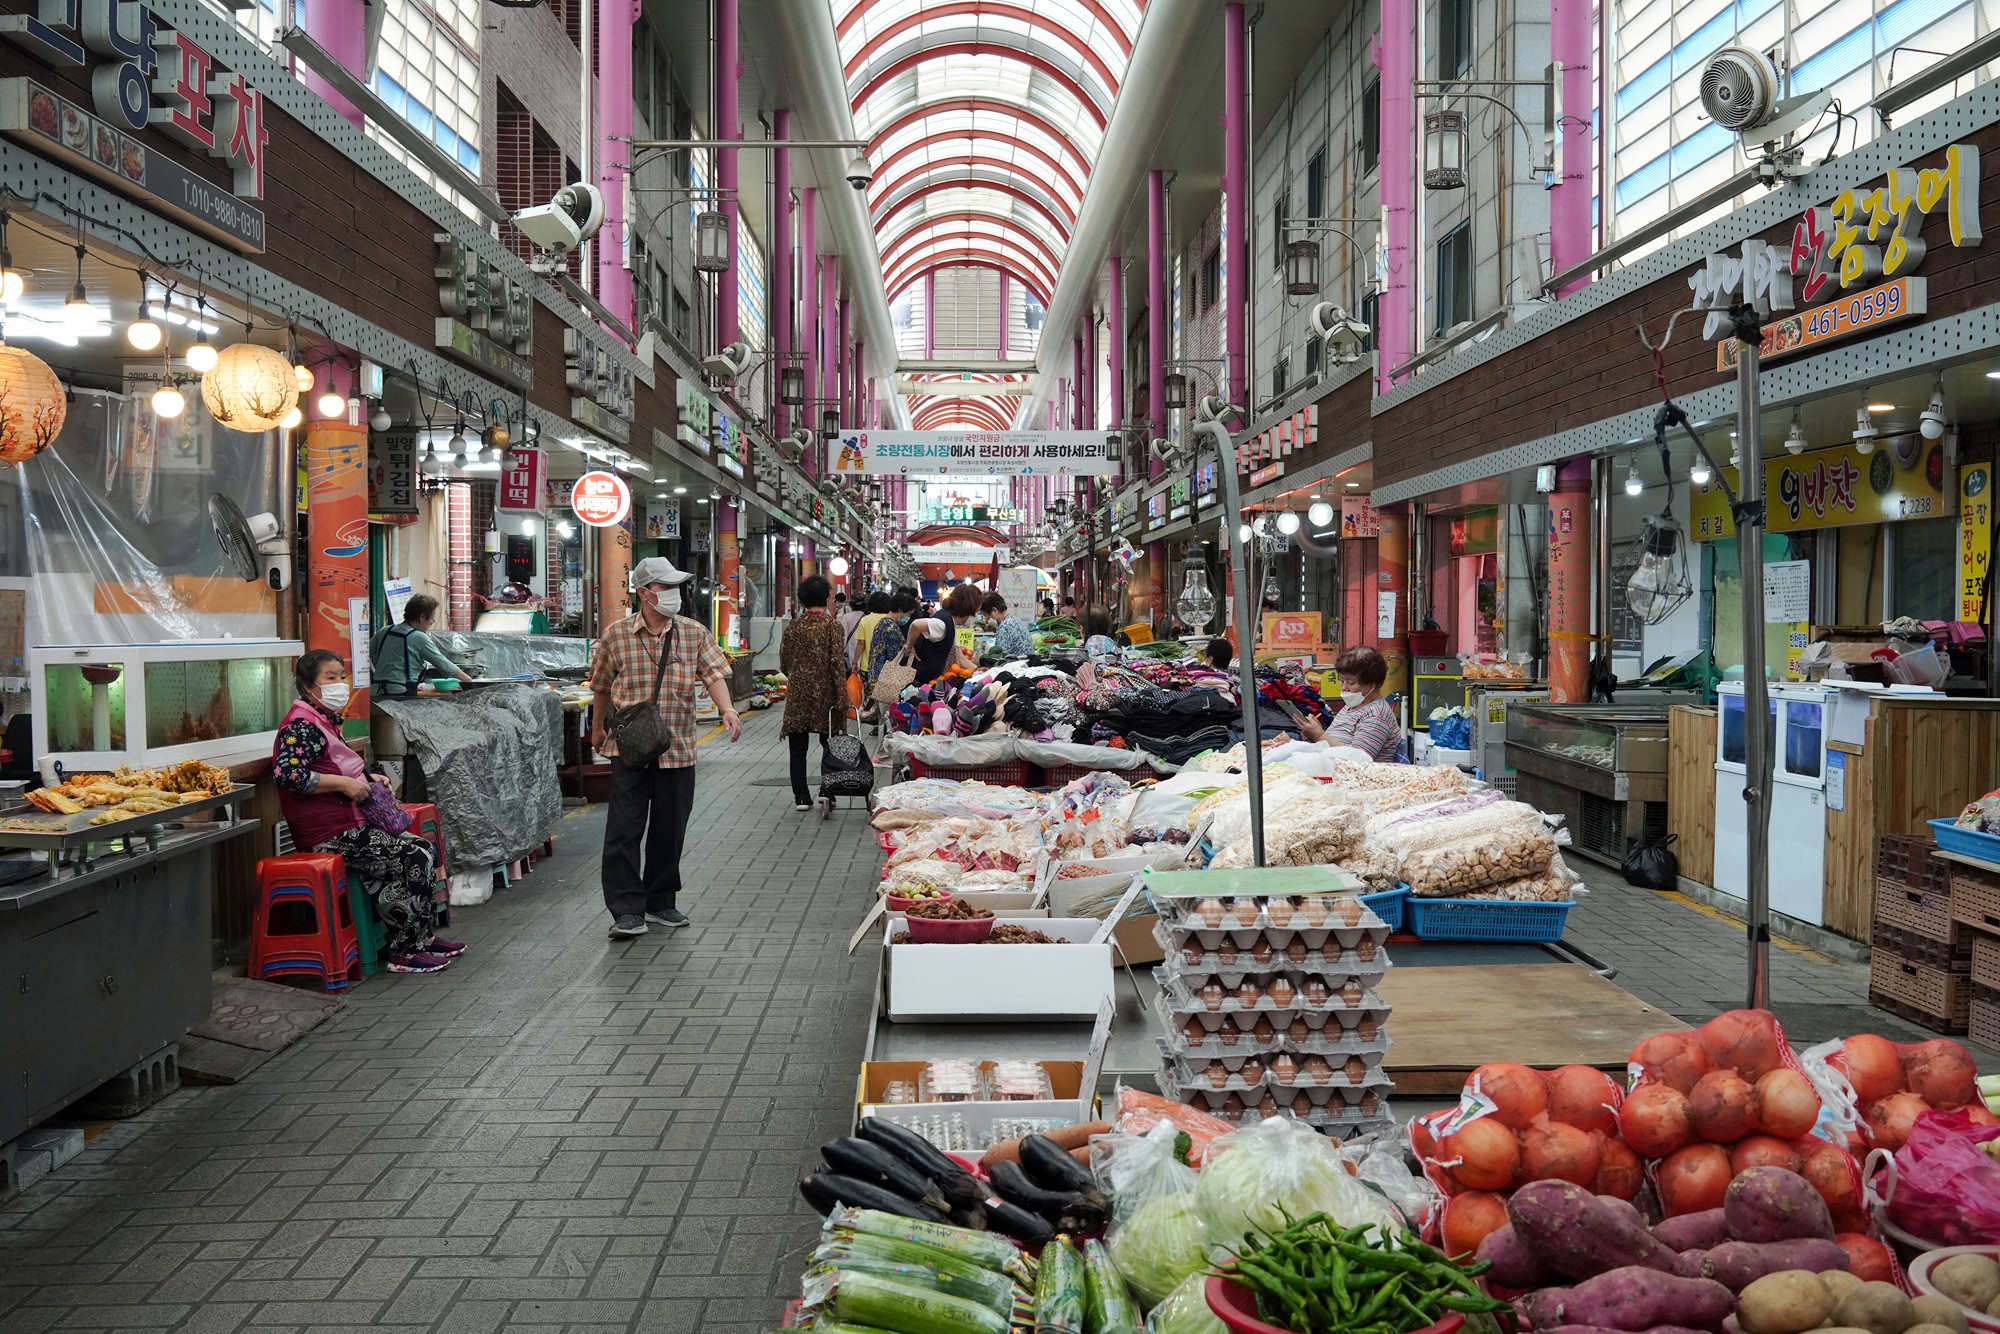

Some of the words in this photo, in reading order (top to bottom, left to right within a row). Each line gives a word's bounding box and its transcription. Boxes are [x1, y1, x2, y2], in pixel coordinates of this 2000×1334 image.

[182, 177, 261, 242] T.010-9880-0310
[1790, 144, 1963, 303] 산곰장어
[1807, 286, 1901, 338] 461-0599
[386, 436, 415, 451] 밀양
[876, 444, 975, 458] 초량전통시장에서
[979, 444, 1030, 458] 편리하게
[1033, 444, 1106, 458] 사용하세요!!
[388, 453, 411, 505] 튀김집
[508, 453, 530, 505] 빈대떡
[1779, 455, 1860, 522] 영반찬
[666, 509, 678, 535] 상회
[1963, 504, 1975, 574] 곰장어
[1964, 577, 1983, 597] 포장
